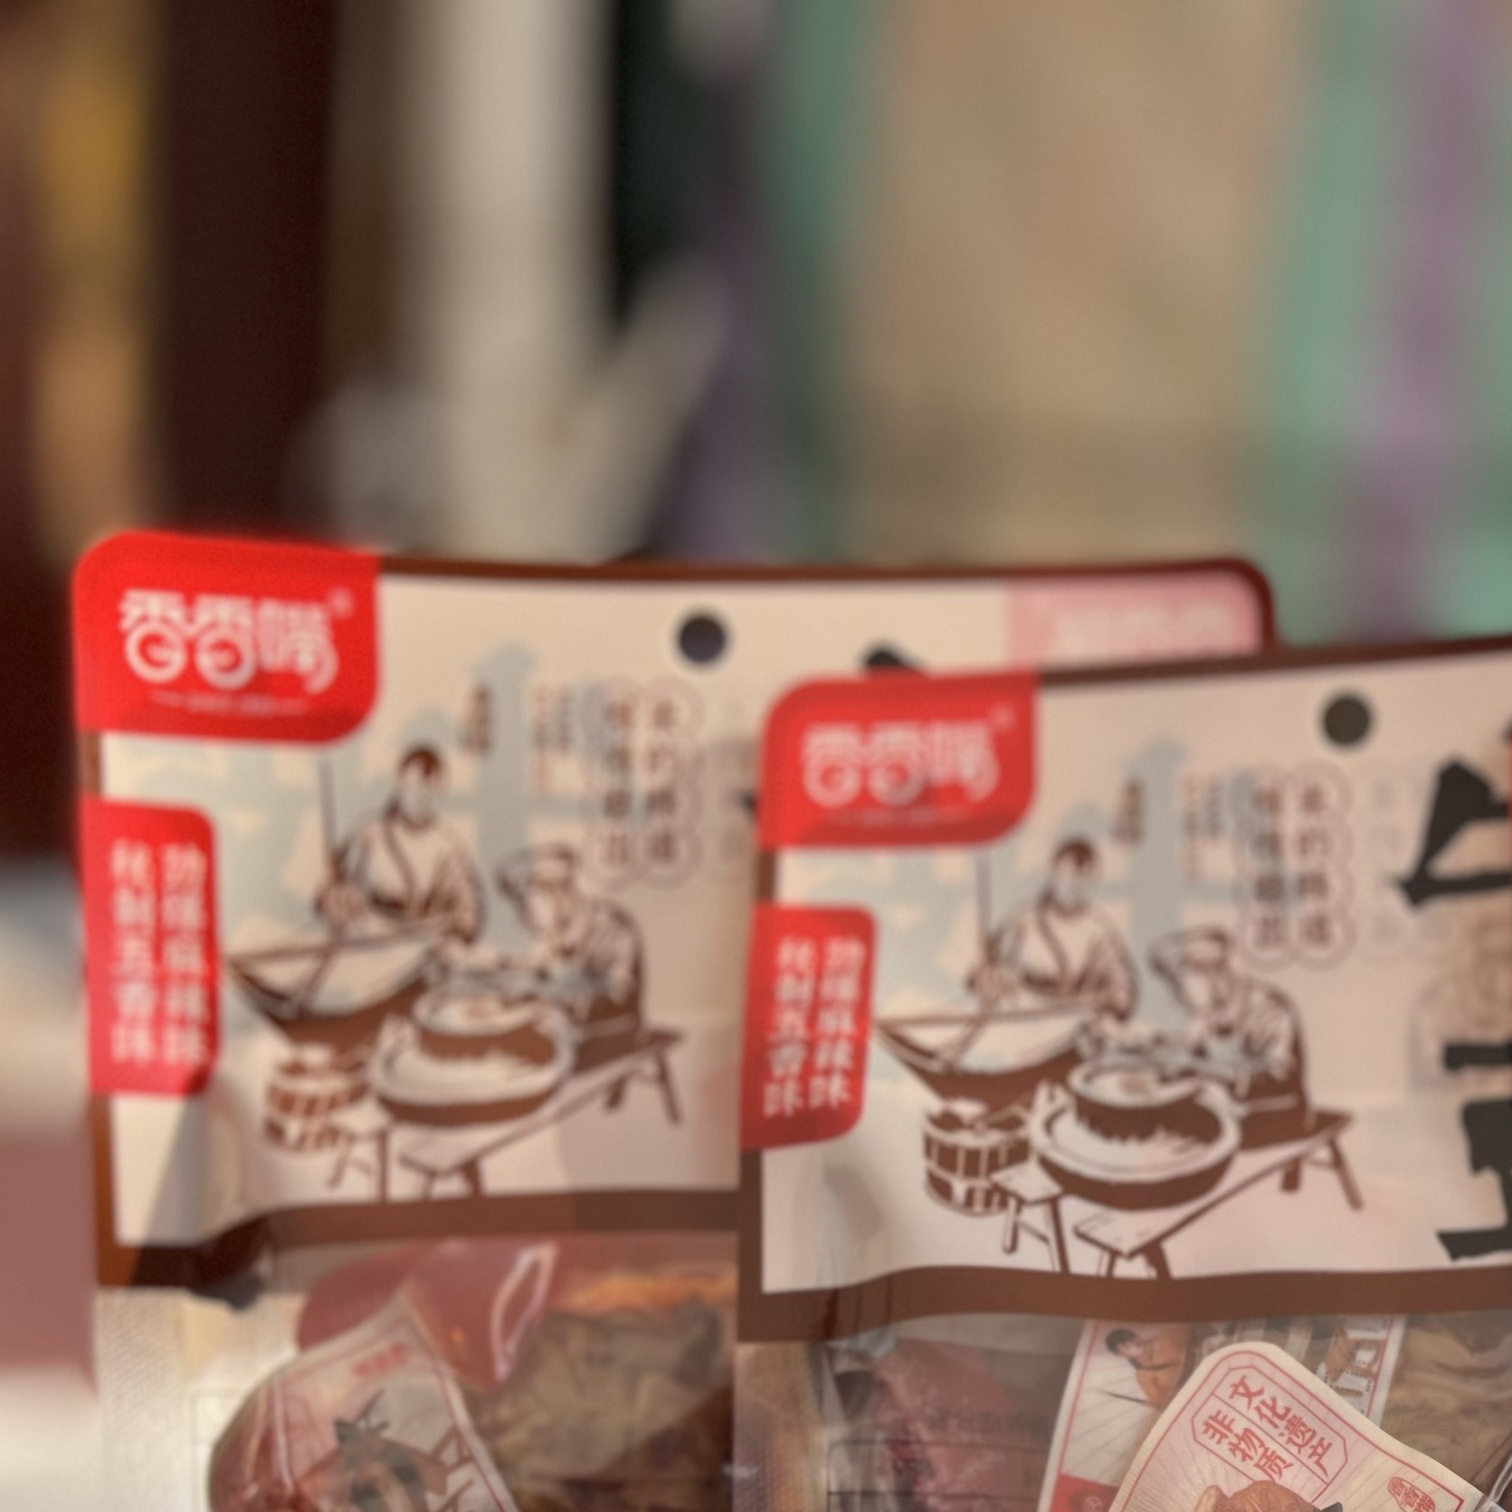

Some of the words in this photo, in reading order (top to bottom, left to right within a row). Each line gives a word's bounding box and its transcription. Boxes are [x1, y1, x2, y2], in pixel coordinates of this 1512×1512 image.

[1201, 1408, 1297, 1482] 非物质
[1227, 1374, 1350, 1476] 文化遗产
